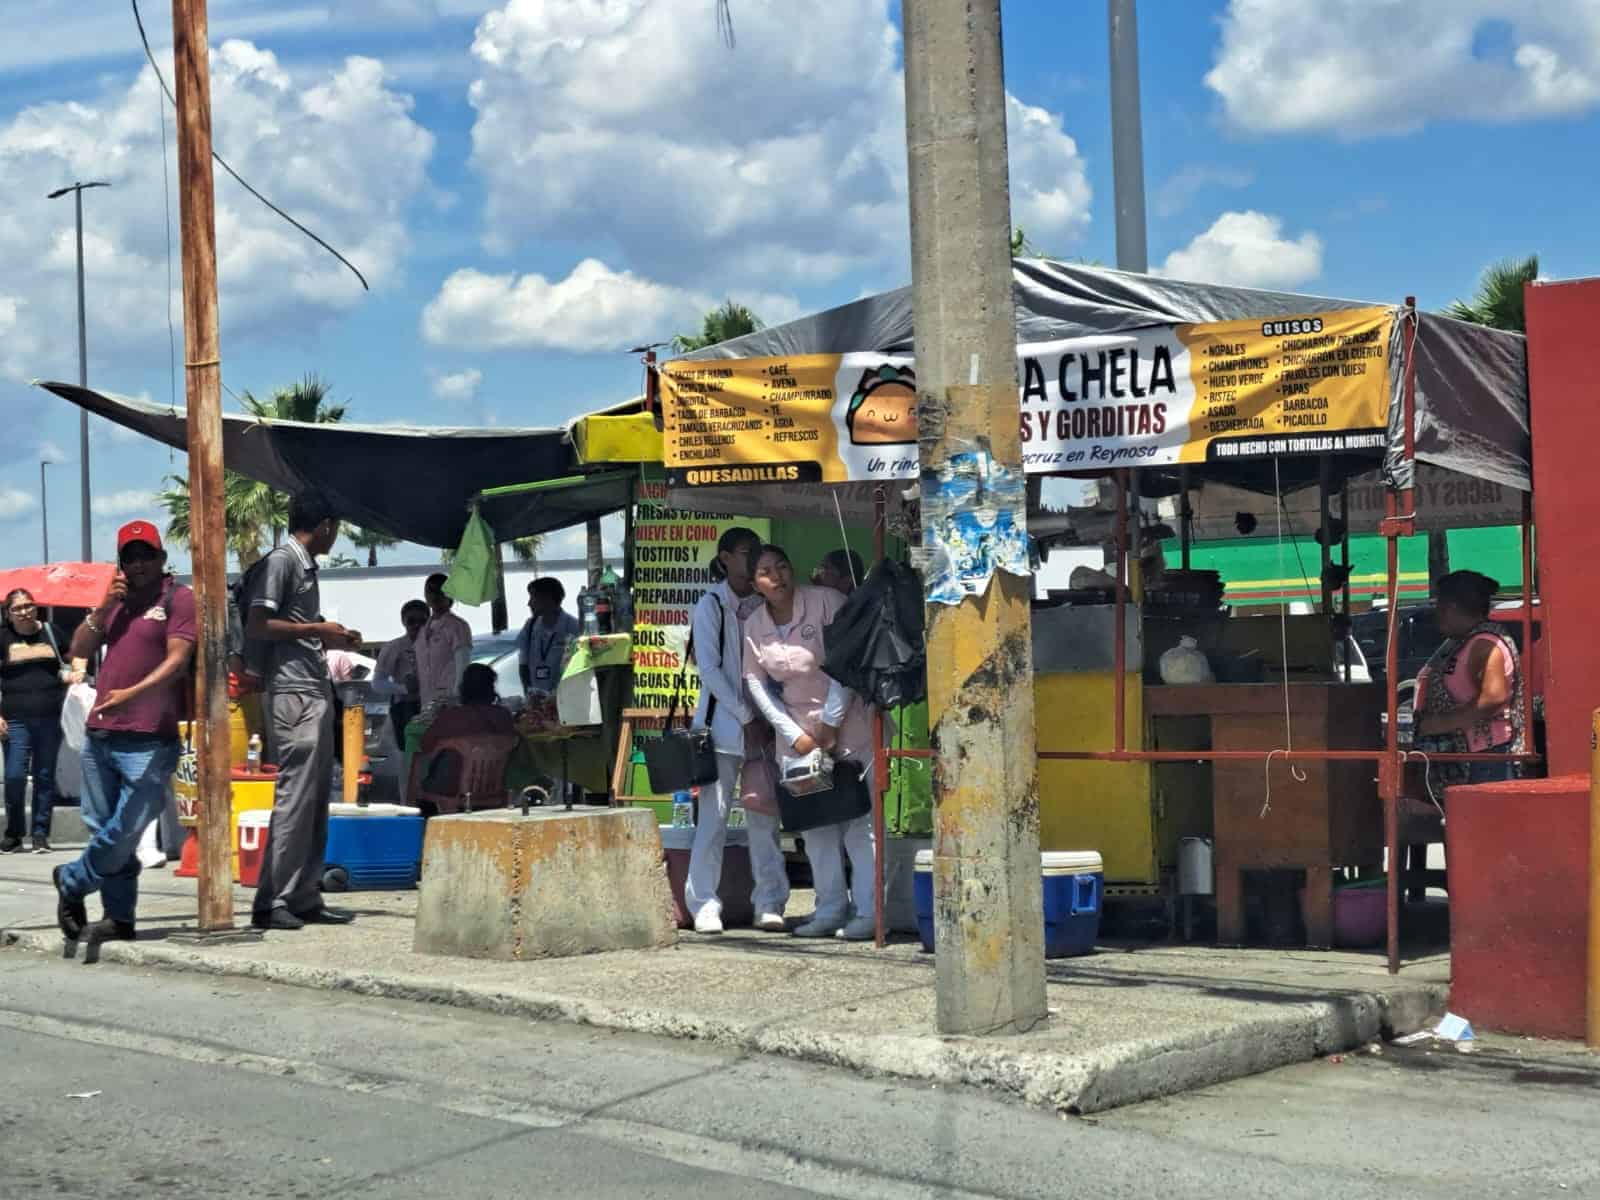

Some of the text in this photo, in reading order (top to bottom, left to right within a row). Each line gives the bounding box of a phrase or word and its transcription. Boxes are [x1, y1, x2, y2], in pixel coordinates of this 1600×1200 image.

[1263, 320, 1322, 336] GUISOS
[1208, 344, 1246, 356] NOPALES
[1058, 345, 1177, 402] CHELA
[1322, 366, 1340, 378] CON
[772, 377, 797, 389] AVENA
[1209, 372, 1265, 389] HUEVO VERDE
[770, 387, 833, 402] CHAMPURRADO
[1209, 389, 1237, 403] BISTEC
[1282, 382, 1310, 396] PAPAS
[710, 406, 746, 418] BARBACOA
[1207, 404, 1237, 418] ASADO
[1283, 397, 1329, 412] BARBACOA
[1038, 410, 1051, 441] Y
[1057, 403, 1168, 441] GORDITAS
[1283, 413, 1328, 428] PICADILLO
[774, 430, 819, 442] REFRESCOS
[1215, 443, 1239, 457] TODO
[1239, 441, 1267, 455] HECHO
[1268, 440, 1287, 453] CON
[1287, 436, 1333, 452] TORTILLAS
[1334, 436, 1345, 449] AL
[867, 457, 886, 472] Un
[1066, 450, 1086, 463] en
[1089, 444, 1159, 464] Reynosa
[686, 465, 799, 486] QUESADILLAS
[635, 525, 718, 541] NIEVE EN CONO
[635, 546, 700, 562] TOSTITOS Y
[632, 630, 665, 647] BOLIS
[631, 650, 680, 668] PALETAS
[632, 671, 670, 689] AGUAS
[632, 693, 695, 709] NATURES
